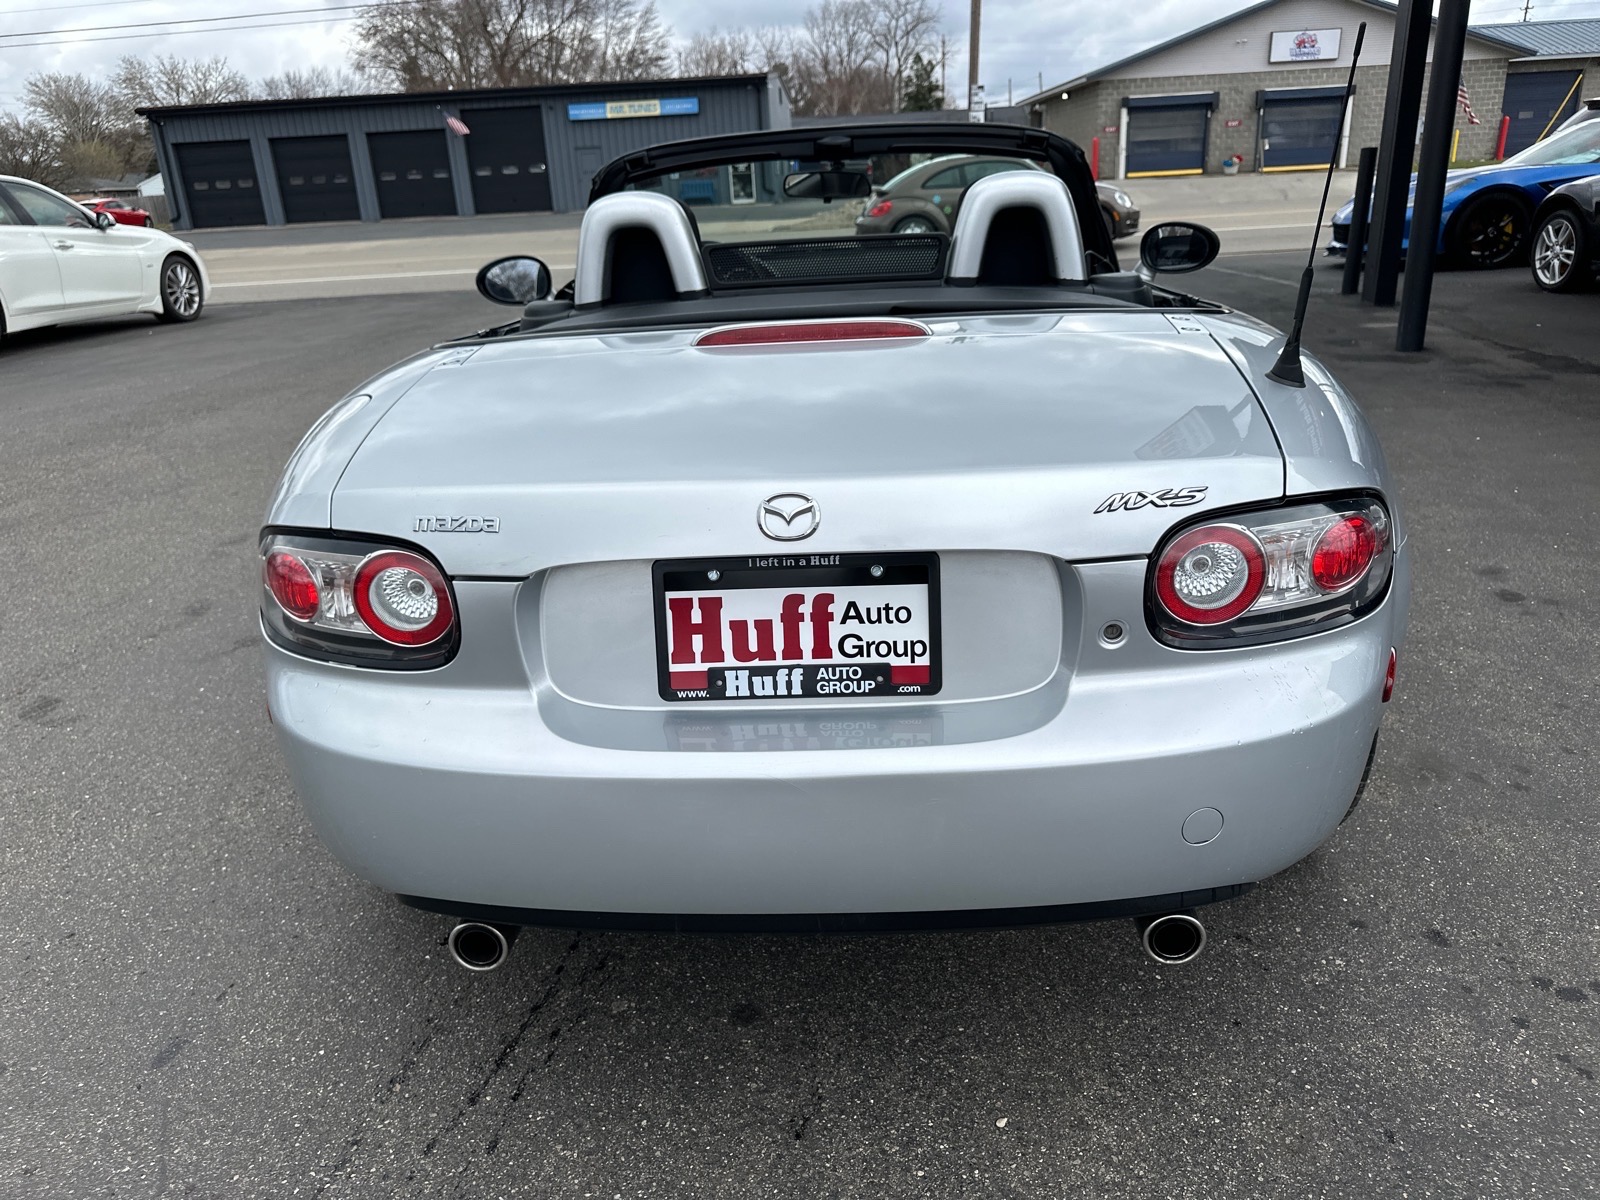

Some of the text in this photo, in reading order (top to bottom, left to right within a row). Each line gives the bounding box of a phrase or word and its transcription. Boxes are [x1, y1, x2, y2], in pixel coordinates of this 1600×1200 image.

[1093, 486, 1208, 514] MX-5
[748, 555, 840, 567] I left in a Huff
[840, 601, 912, 624] Auto
[669, 593, 834, 664] Huff
[837, 633, 928, 664] Group
[677, 669, 803, 698] www. Huff
[816, 667, 862, 679] AUTO
[816, 680, 921, 694] GROUP .com
